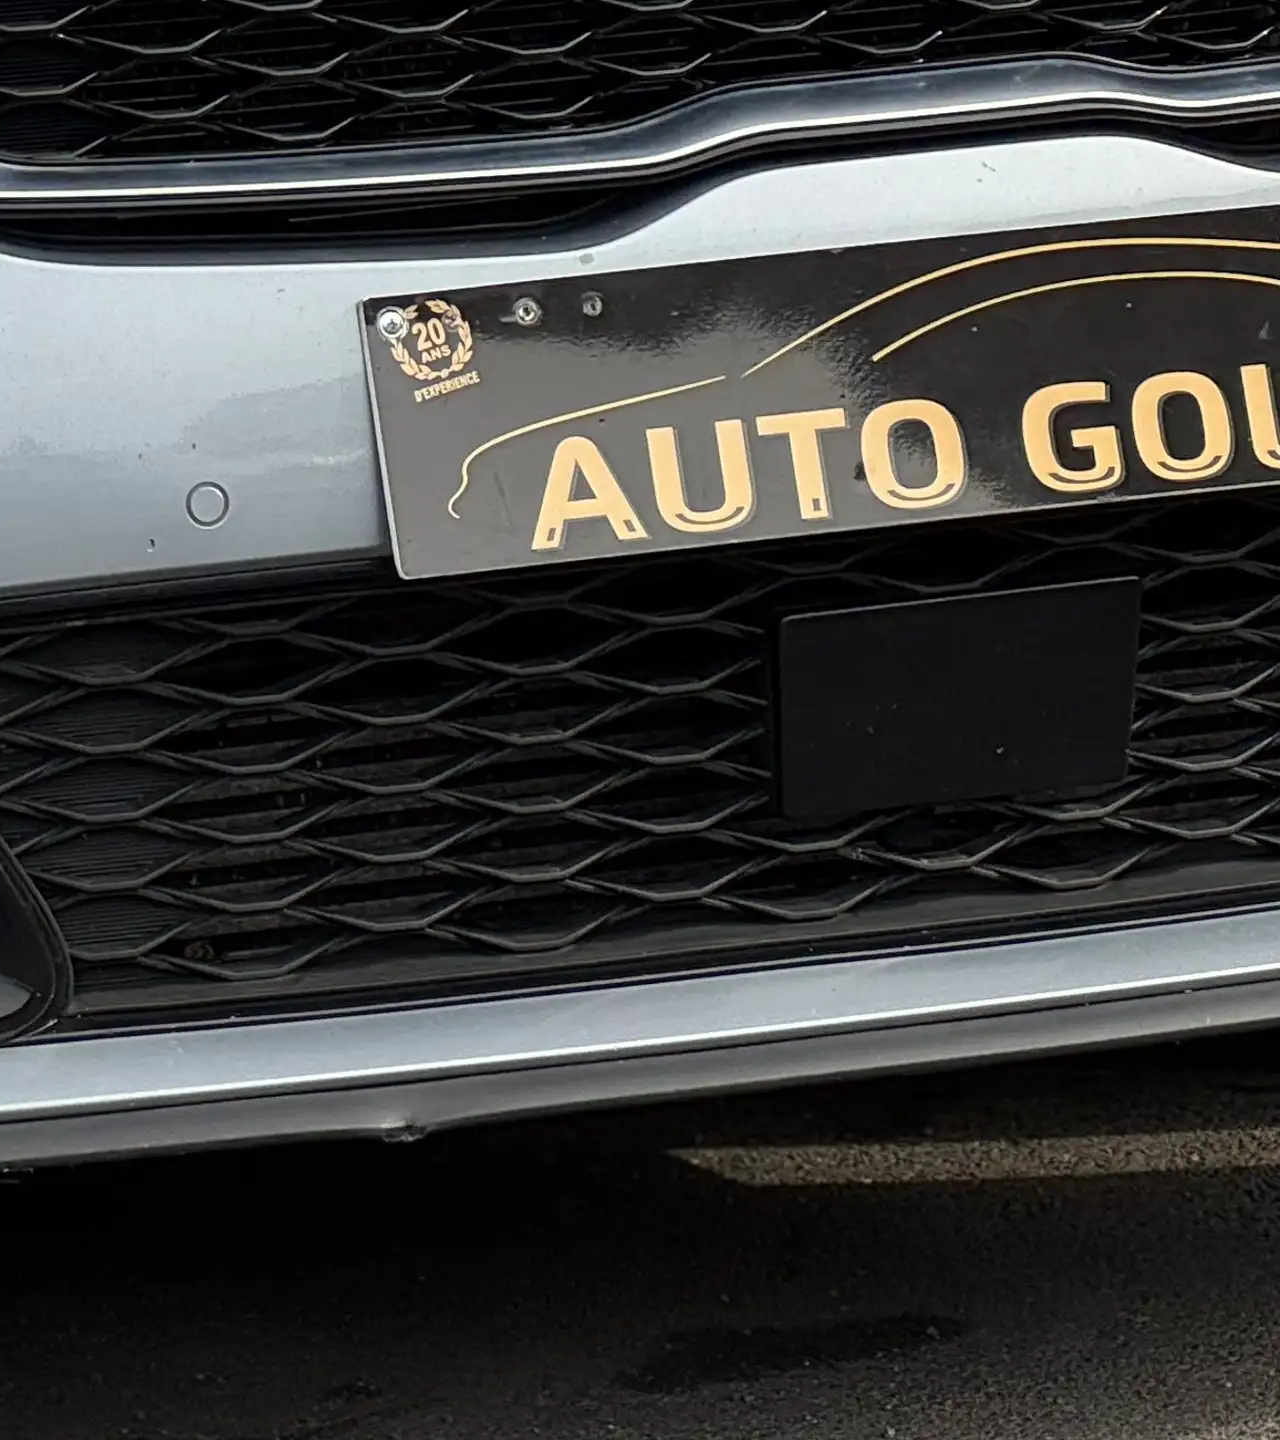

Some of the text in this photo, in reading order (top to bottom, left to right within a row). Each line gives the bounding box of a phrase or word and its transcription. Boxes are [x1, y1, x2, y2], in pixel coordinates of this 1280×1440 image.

[412, 318, 446, 352] 20
[422, 345, 452, 364] ANS
[531, 398, 968, 552] AUTO
